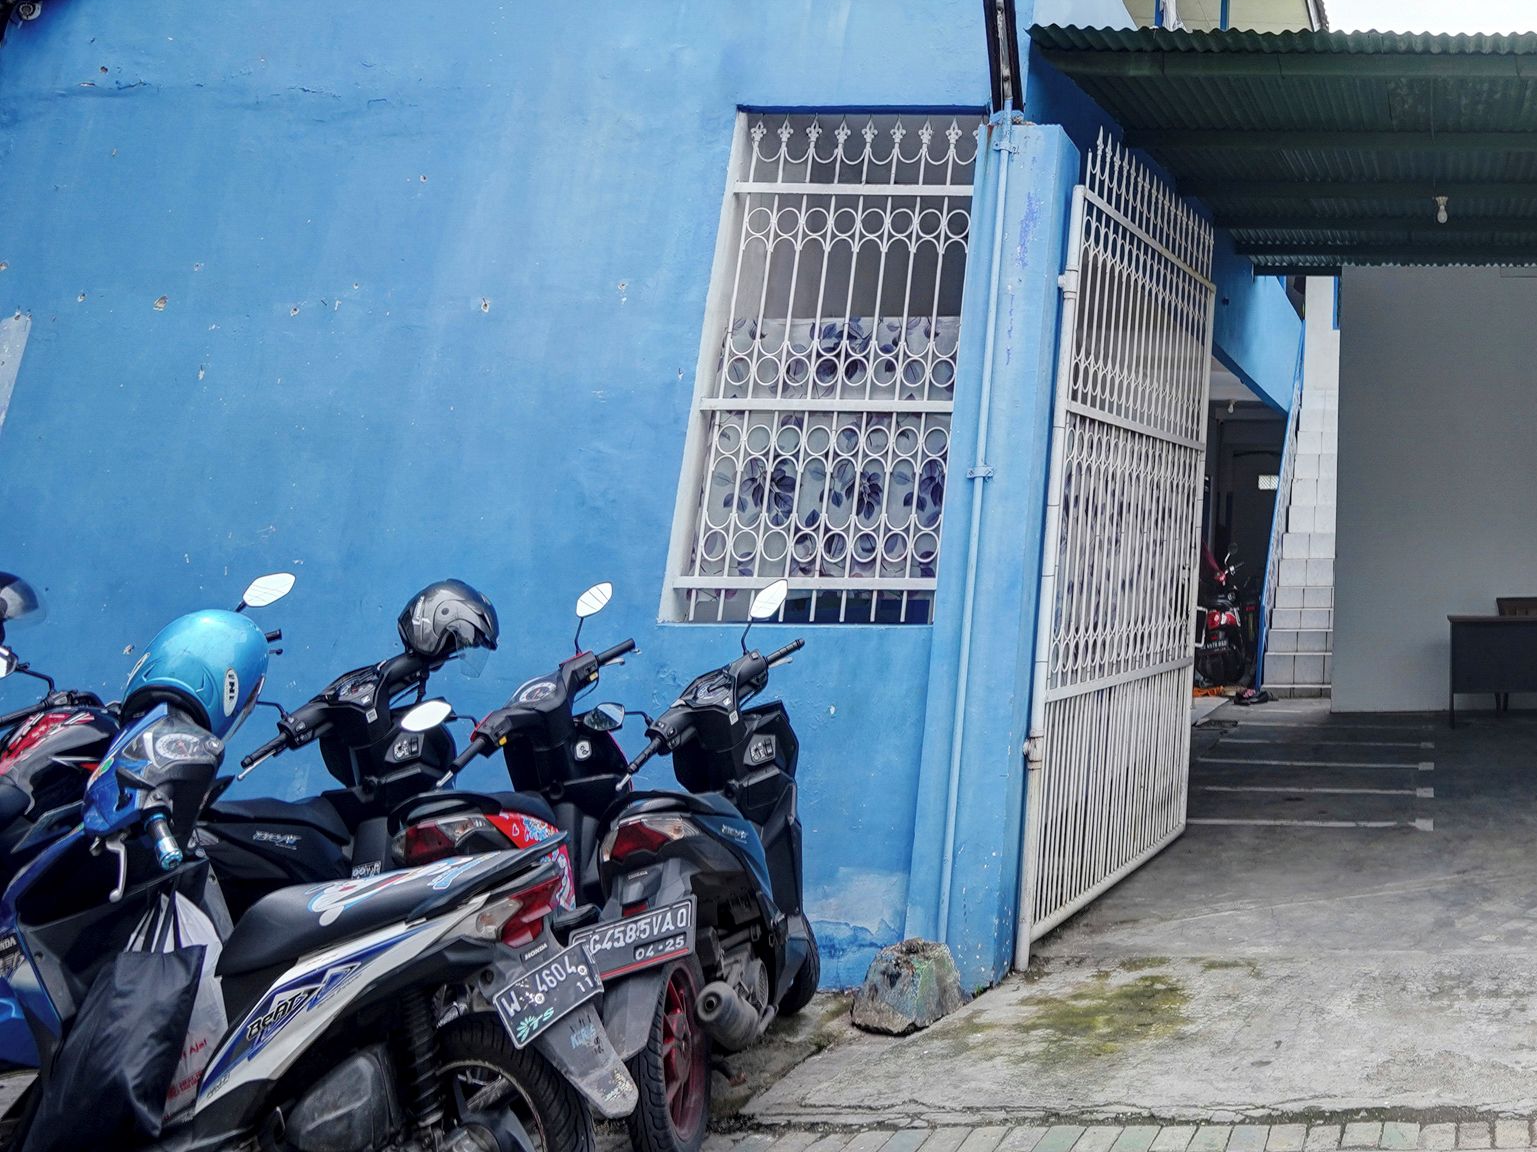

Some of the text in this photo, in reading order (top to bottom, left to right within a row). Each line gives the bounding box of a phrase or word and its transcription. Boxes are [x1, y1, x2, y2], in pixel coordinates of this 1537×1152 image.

[524, 942, 548, 961] HONDA
[501, 955, 578, 1017] W 4604
